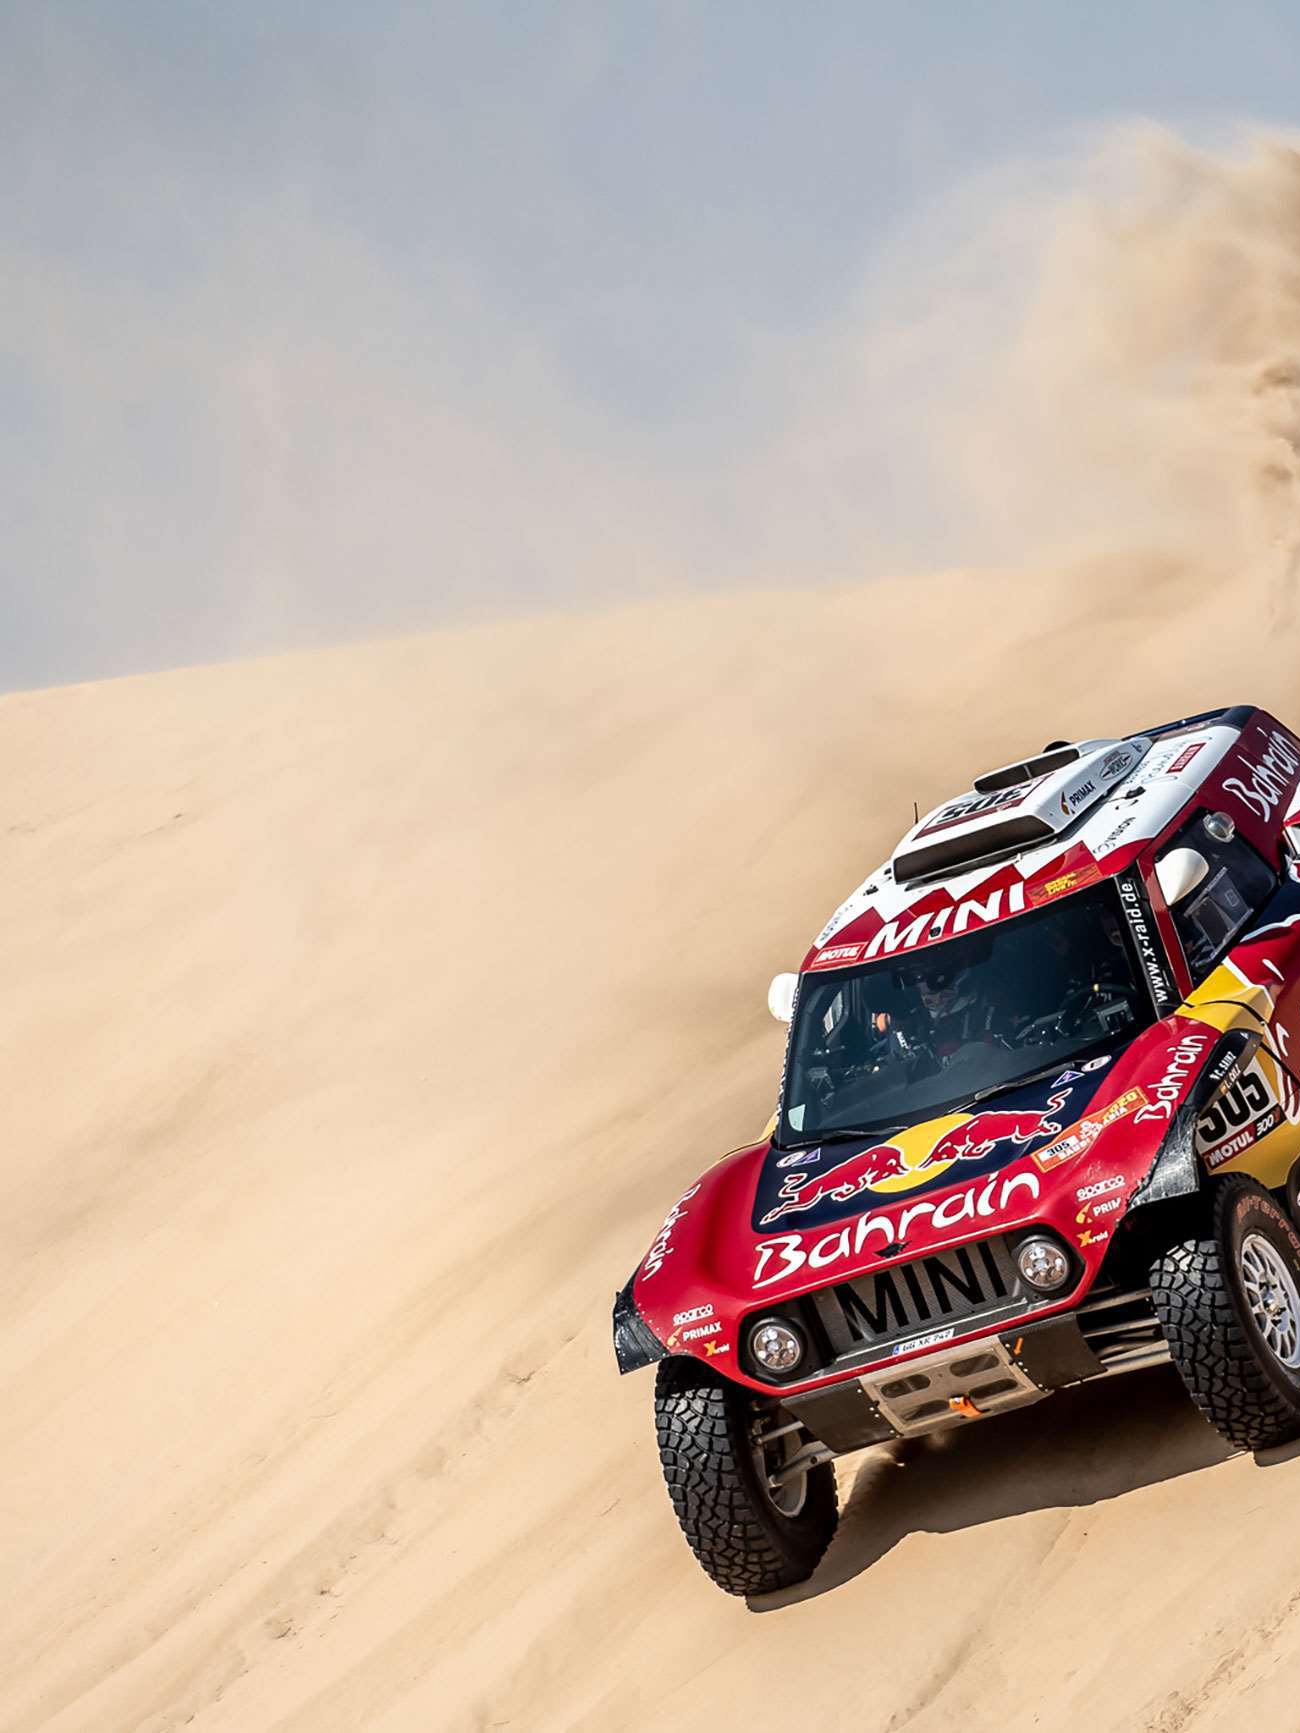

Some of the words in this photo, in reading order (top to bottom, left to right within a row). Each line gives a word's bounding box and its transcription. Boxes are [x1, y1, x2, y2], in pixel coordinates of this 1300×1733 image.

[1068, 780, 1097, 807] PRIMAX
[1222, 727, 1300, 823] Bahrain
[863, 881, 1026, 960] MINI
[1120, 882, 1169, 1003] www.x-raid.de
[1133, 1034, 1208, 1125] Bahrain
[1046, 1141, 1070, 1157] 305
[1076, 1175, 1126, 1201] sparco
[1206, 1132, 1255, 1169] MOTUL
[642, 1183, 702, 1282] Bahrain
[751, 1171, 1040, 1290] Bahrain
[683, 1321, 722, 1342] PRIMAX
[832, 1240, 1008, 1342] MINI
